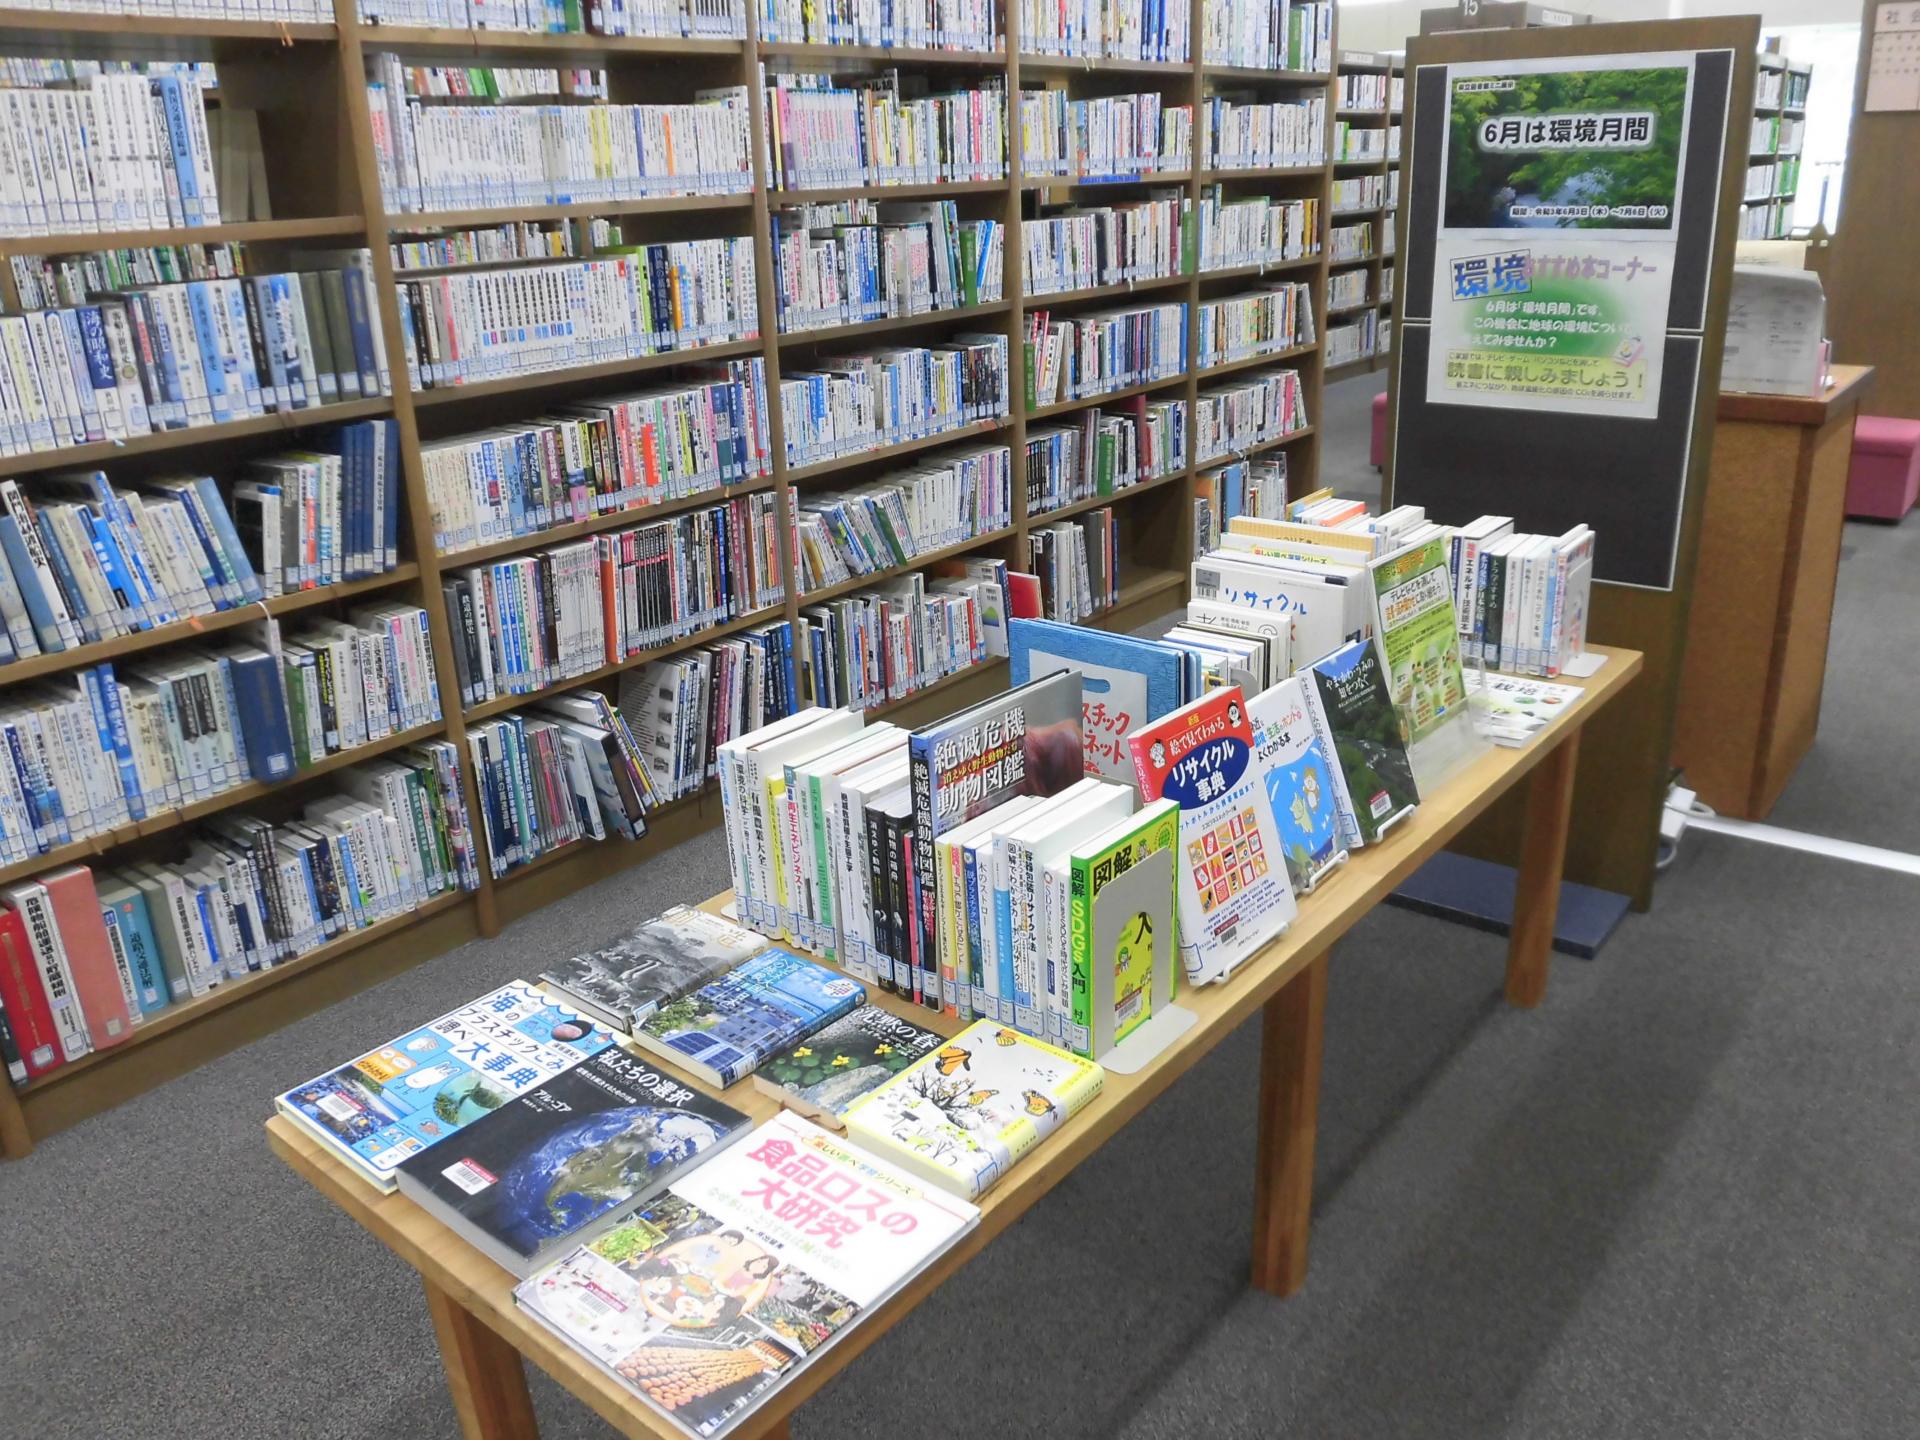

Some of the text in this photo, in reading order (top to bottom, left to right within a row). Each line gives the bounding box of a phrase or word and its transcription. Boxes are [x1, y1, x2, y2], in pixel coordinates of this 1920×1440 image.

[1485, 117, 1649, 144] 6月は環境月間
[1453, 254, 1529, 297] 環境
[1446, 361, 1644, 389] 読書に親しみましょう！
[1225, 587, 1308, 615] リサイクル
[934, 706, 1025, 775] 絶滅危機
[1169, 716, 1226, 757] 絵で見てわかる
[1172, 739, 1235, 788] リサイクル
[936, 749, 1026, 818] 動物図鑑
[1195, 770, 1226, 802] 事典
[751, 792, 767, 866] 有機農業大全
[913, 762, 935, 887] 絶滅危機動物図鑑
[979, 861, 989, 927] 木のストロー
[435, 1019, 539, 1089] 調べ 大事典
[459, 1007, 566, 1071] プラスチックごみ
[533, 1088, 573, 1113] アル・ゴア
[598, 1049, 696, 1107] 私たちの選択
[741, 1176, 864, 1249] 大研究
[746, 1137, 919, 1235] 食品ロスの
